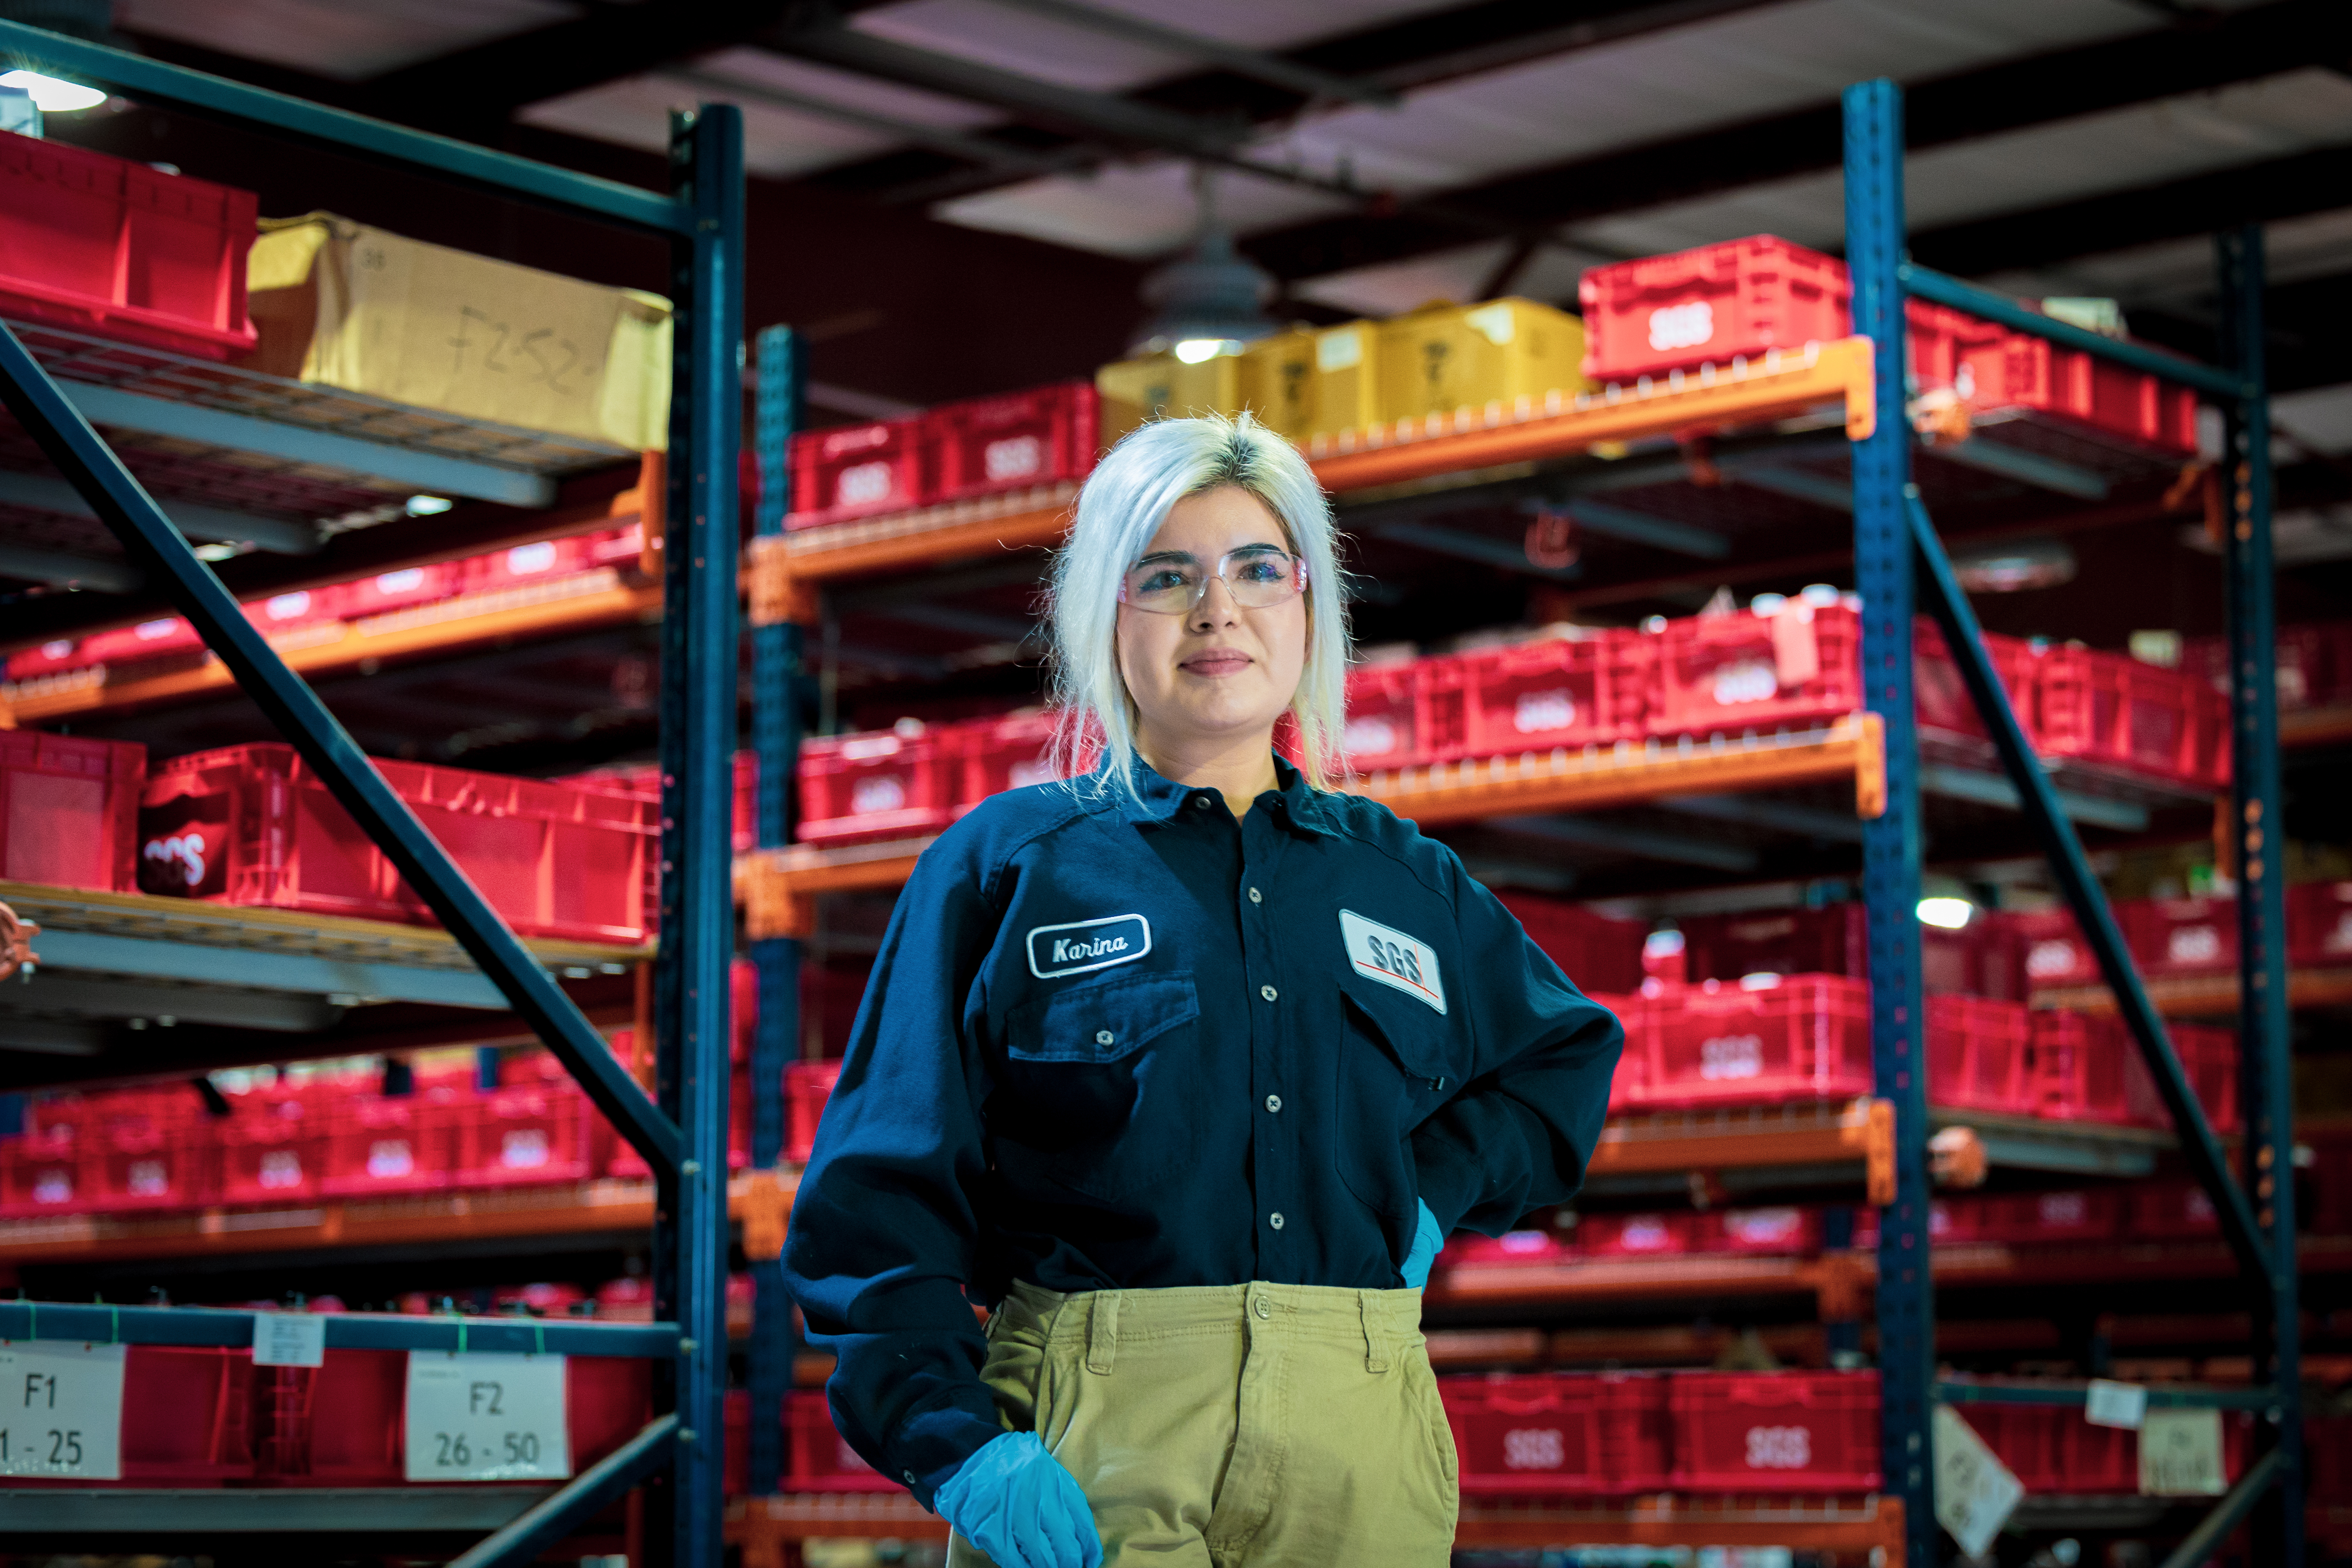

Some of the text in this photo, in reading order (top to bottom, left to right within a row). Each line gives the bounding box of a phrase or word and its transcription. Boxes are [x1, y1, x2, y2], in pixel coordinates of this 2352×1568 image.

[1052, 936, 1128, 962] Karina
[1367, 935, 1422, 985] SGS
[24, 1374, 55, 1408] F1
[470, 1380, 504, 1415] F2
[48, 1429, 82, 1466] 25
[435, 1432, 472, 1466] 26
[504, 1431, 540, 1464] 50
